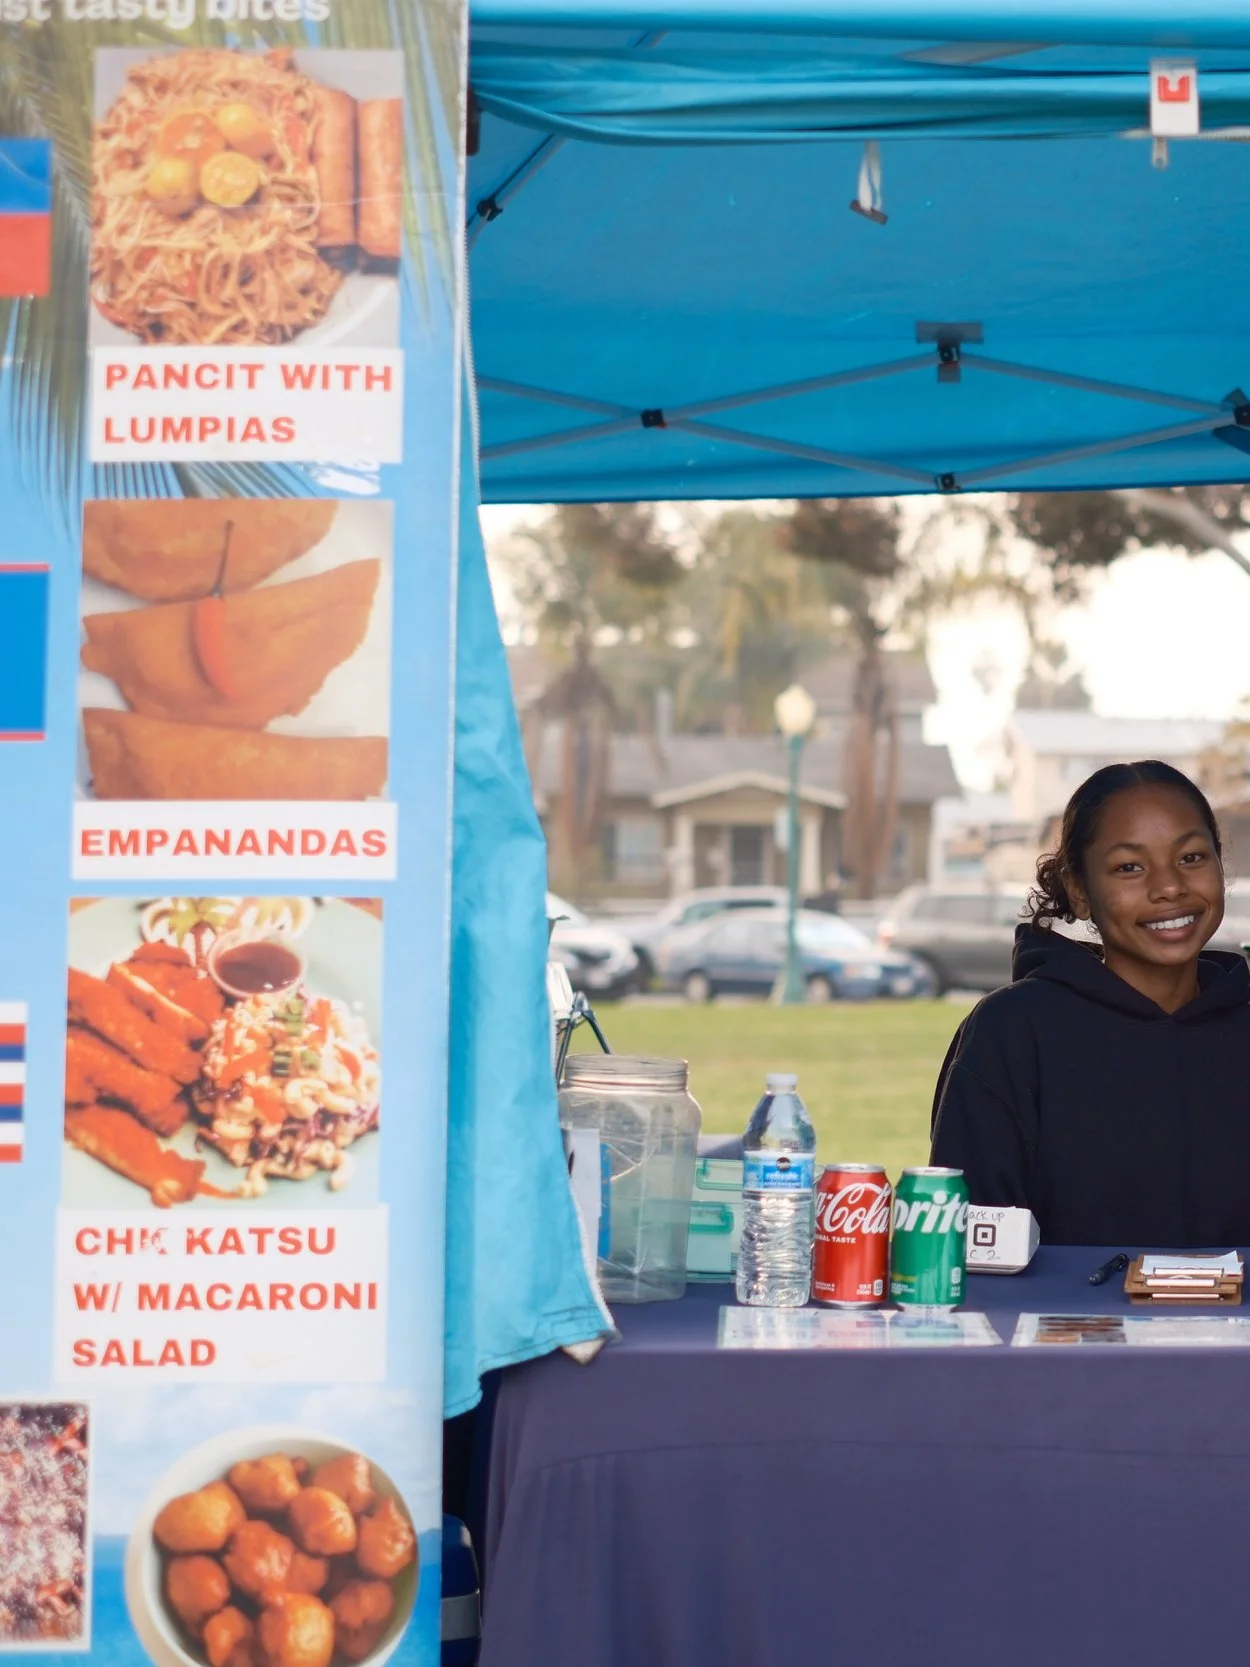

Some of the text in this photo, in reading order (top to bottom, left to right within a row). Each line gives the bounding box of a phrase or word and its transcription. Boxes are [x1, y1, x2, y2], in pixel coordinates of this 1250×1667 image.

[0, 0, 332, 29] st tasty bites
[105, 363, 393, 392] PANCIT WITH
[104, 416, 297, 444] LUMPIAS
[80, 828, 388, 857] EMPANANDAS
[968, 1210, 987, 1220] ack
[185, 1227, 337, 1256] KATSU
[831, 1236, 857, 1244] TASTE
[73, 1281, 378, 1313] W/ MACARONI
[72, 1338, 217, 1367] SALAD
